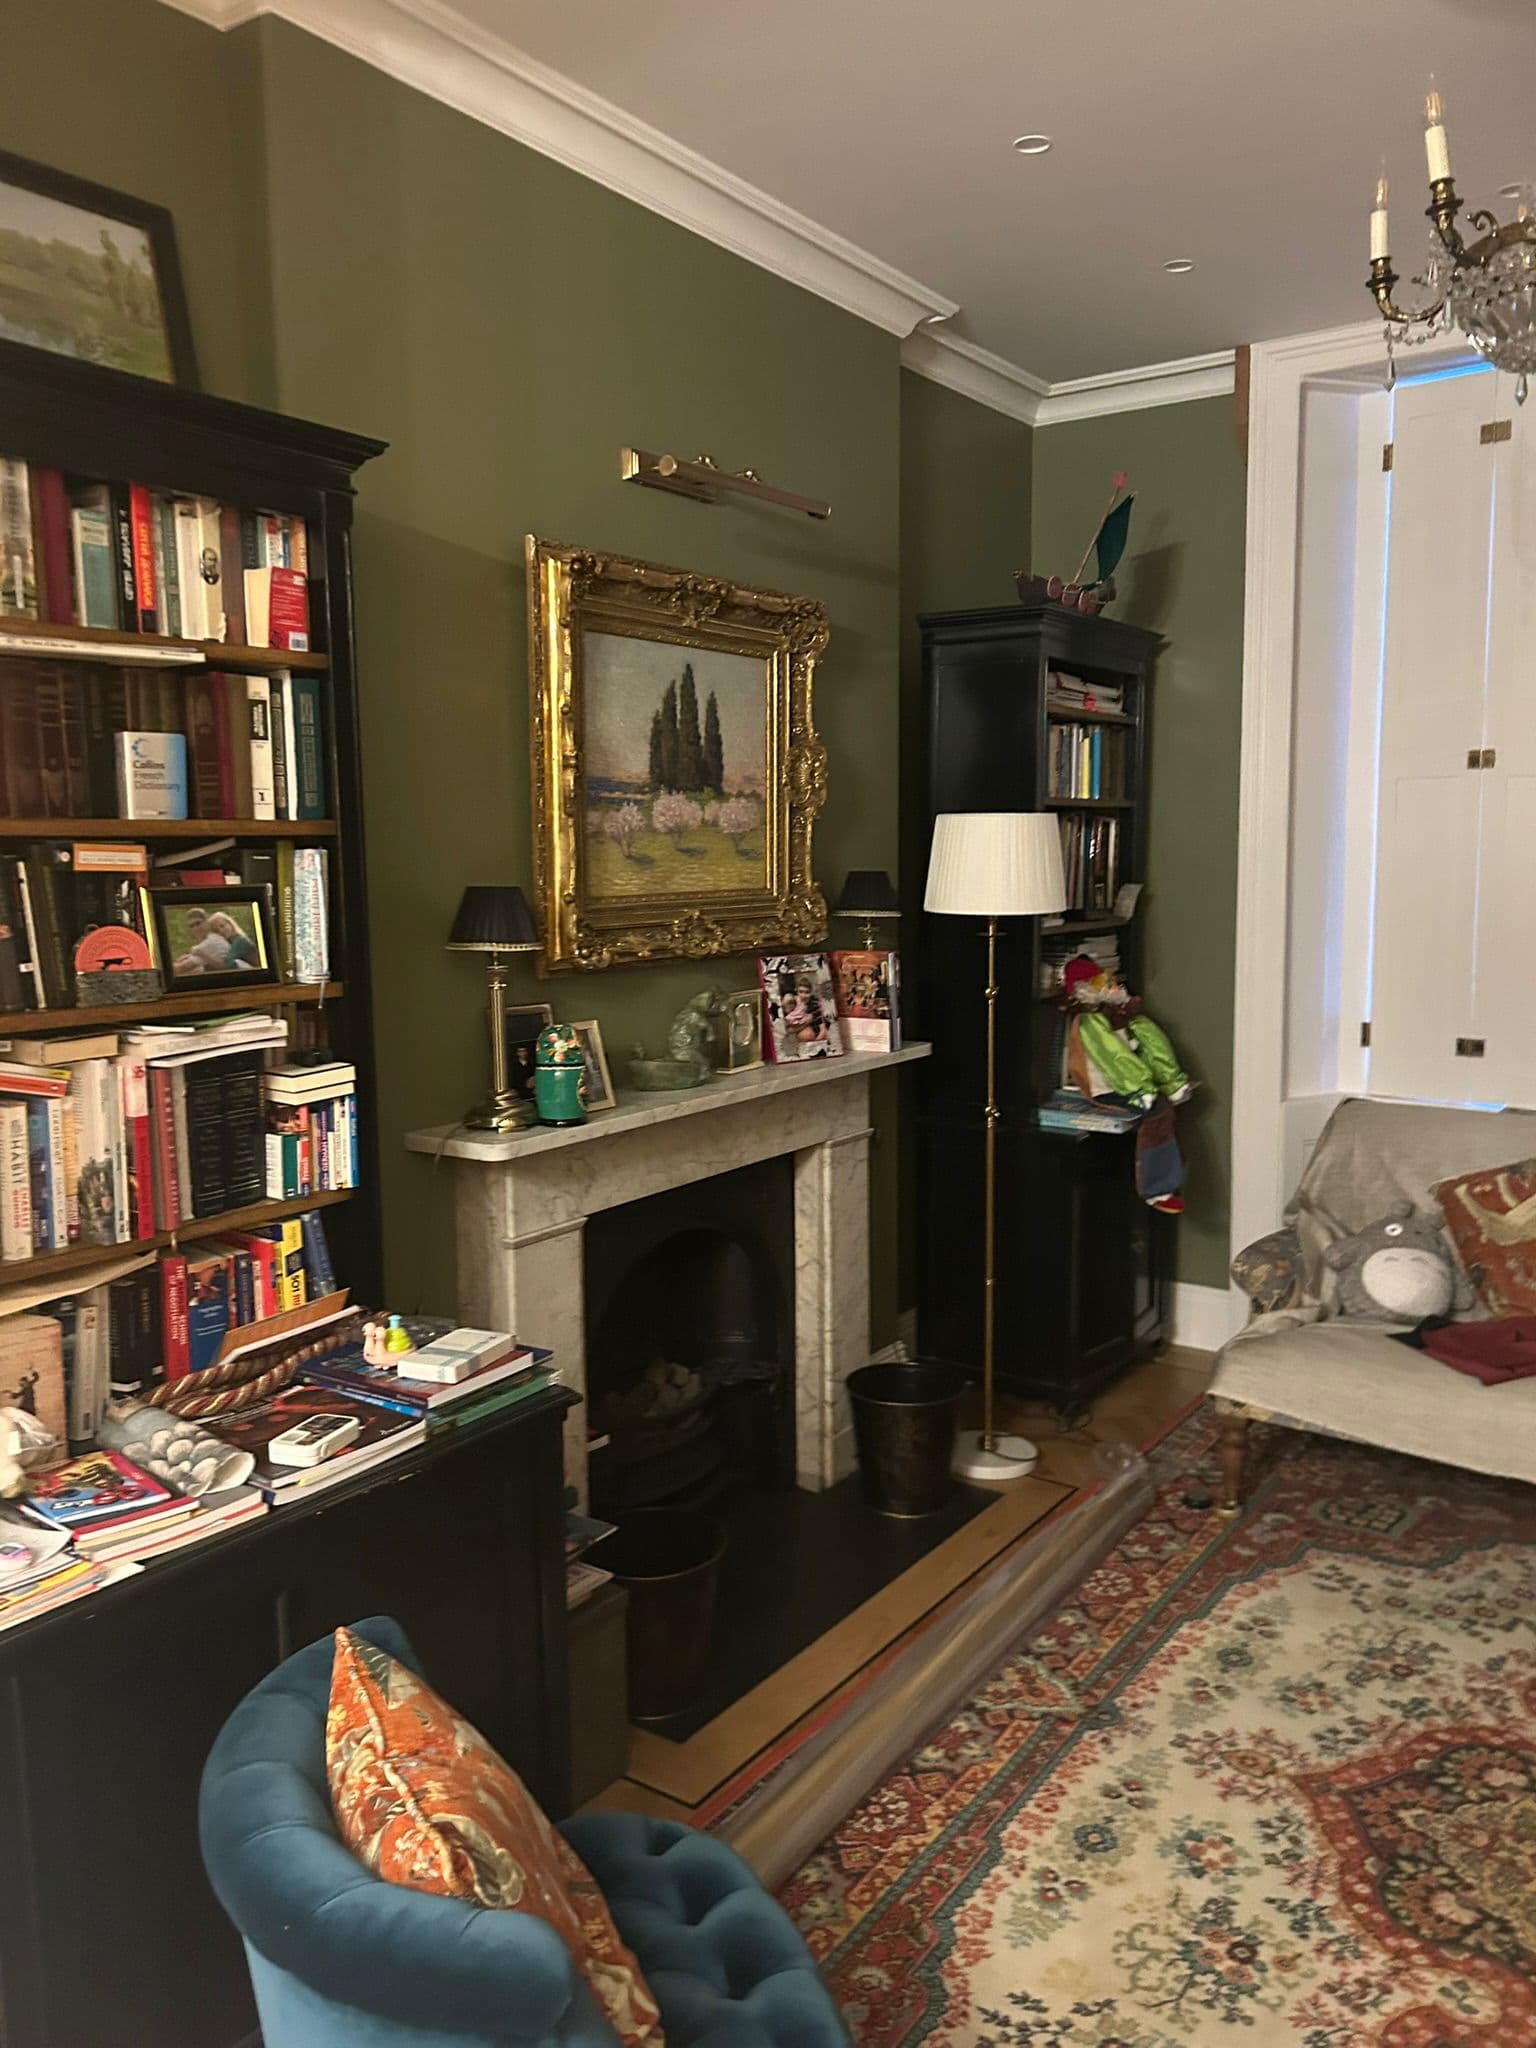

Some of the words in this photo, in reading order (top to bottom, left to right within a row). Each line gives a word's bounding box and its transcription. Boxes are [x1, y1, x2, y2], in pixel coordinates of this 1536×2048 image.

[132, 759, 165, 769] Collins
[133, 770, 164, 779] French
[134, 780, 181, 792] Dictionary
[11, 1139, 26, 1184] HABIT
[321, 1141, 329, 1172] GERMAN
[168, 1274, 177, 1285] OF
[176, 1265, 185, 1279] THE
[291, 1275, 300, 1292] 501
[169, 1286, 179, 1340] NEGOTIATION
[179, 1314, 189, 1345] SCHOOL
